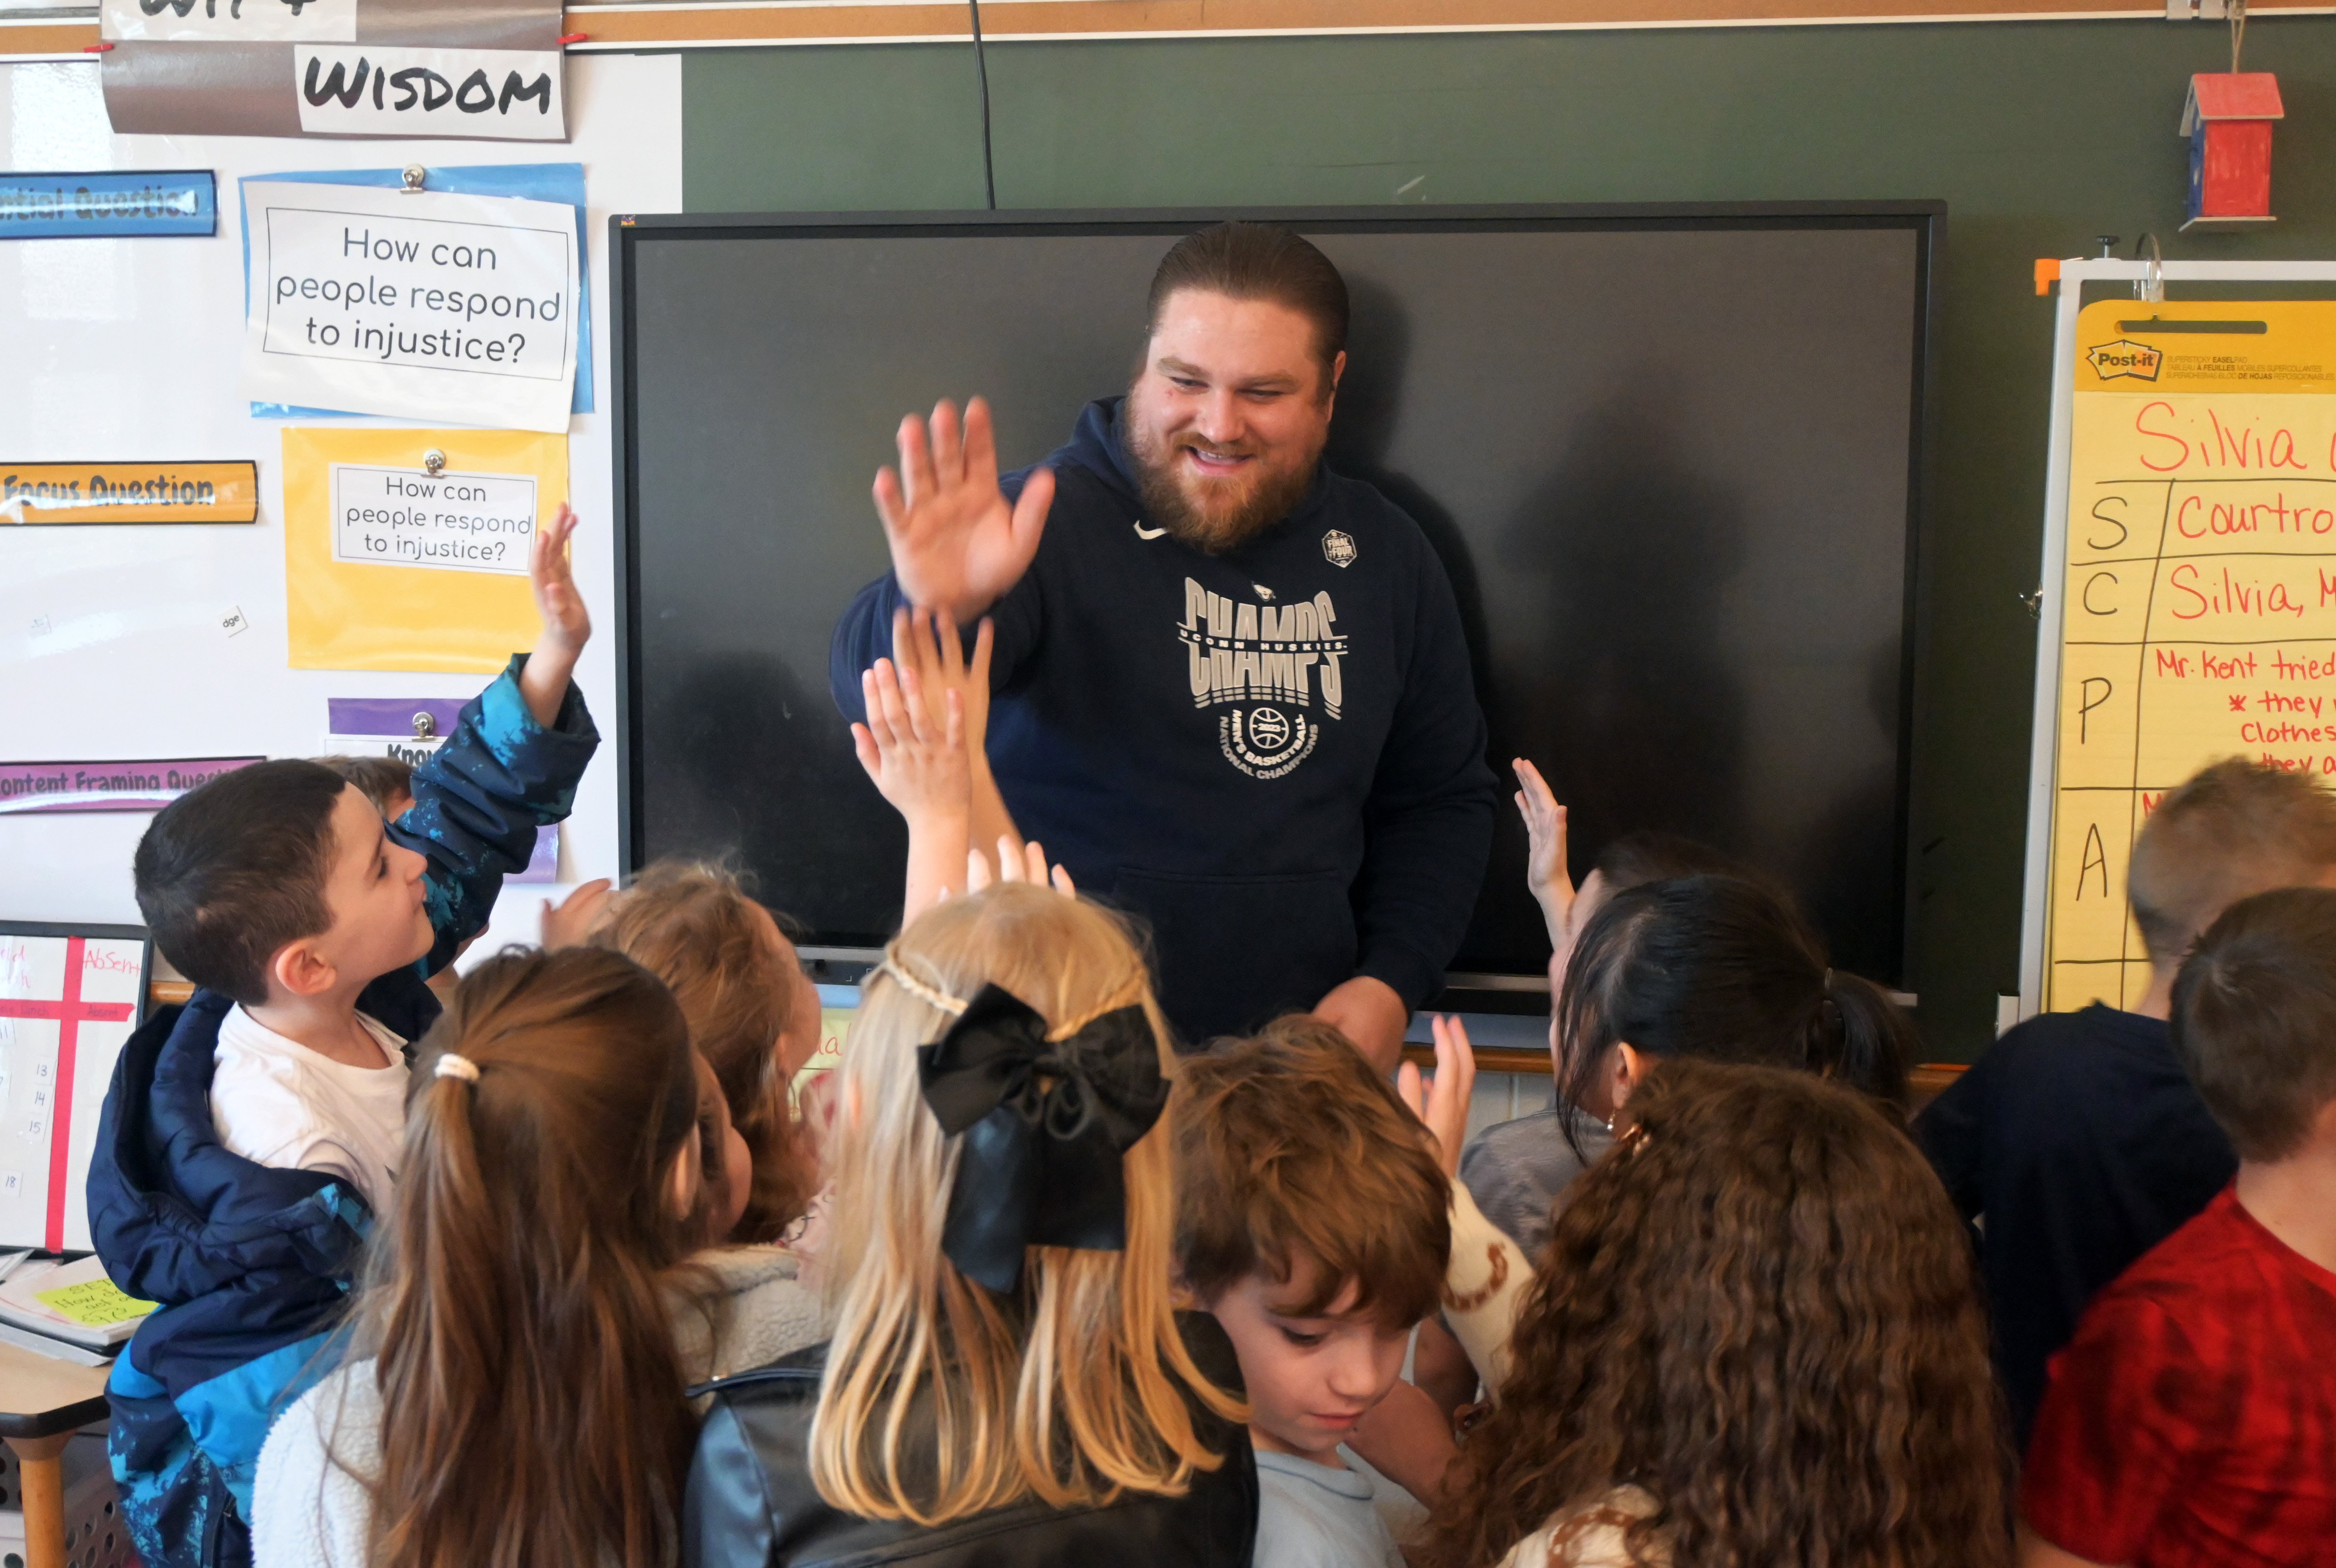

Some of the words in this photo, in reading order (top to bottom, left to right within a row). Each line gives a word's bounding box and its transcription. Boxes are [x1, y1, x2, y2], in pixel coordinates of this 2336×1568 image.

[304, 55, 551, 114] WISDOM
[344, 227, 419, 262] How
[432, 244, 496, 270] can
[277, 275, 397, 310] people
[411, 287, 560, 322] respond
[306, 317, 339, 345] to
[355, 319, 525, 363] injustice?
[2098, 352, 2154, 367] Post-it
[2136, 401, 2307, 472] Silvia
[4, 474, 80, 506] Focus
[89, 474, 214, 507] Question
[387, 476, 436, 498] How
[444, 486, 486, 502] can
[347, 506, 426, 529] people
[435, 513, 531, 535] respond
[2088, 497, 2127, 550] S
[364, 534, 387, 552] to
[397, 534, 506, 561] injustice?
[1327, 537, 1349, 548] FINAL
[1332, 545, 1352, 559] FOUR
[2083, 572, 2118, 615] C
[2171, 564, 2303, 619] Silvia,
[1179, 629, 1245, 649] UCONN
[1261, 642, 1344, 651] HUSKIES
[2156, 648, 2194, 678] Mr.
[2271, 649, 2336, 680] tried
[2079, 677, 2112, 744] P
[2257, 690, 2322, 719] they
[1219, 715, 1255, 777] NATIONAL
[1255, 724, 1319, 779] CHAMPIONS
[1244, 713, 1306, 766] BASKETBALL
[0, 772, 69, 796] ontent
[2076, 823, 2107, 901] A
[36, 1063, 48, 1077] 13
[34, 1090, 45, 1105] 14
[29, 1120, 41, 1133] 15
[5, 1175, 16, 1188] 18
